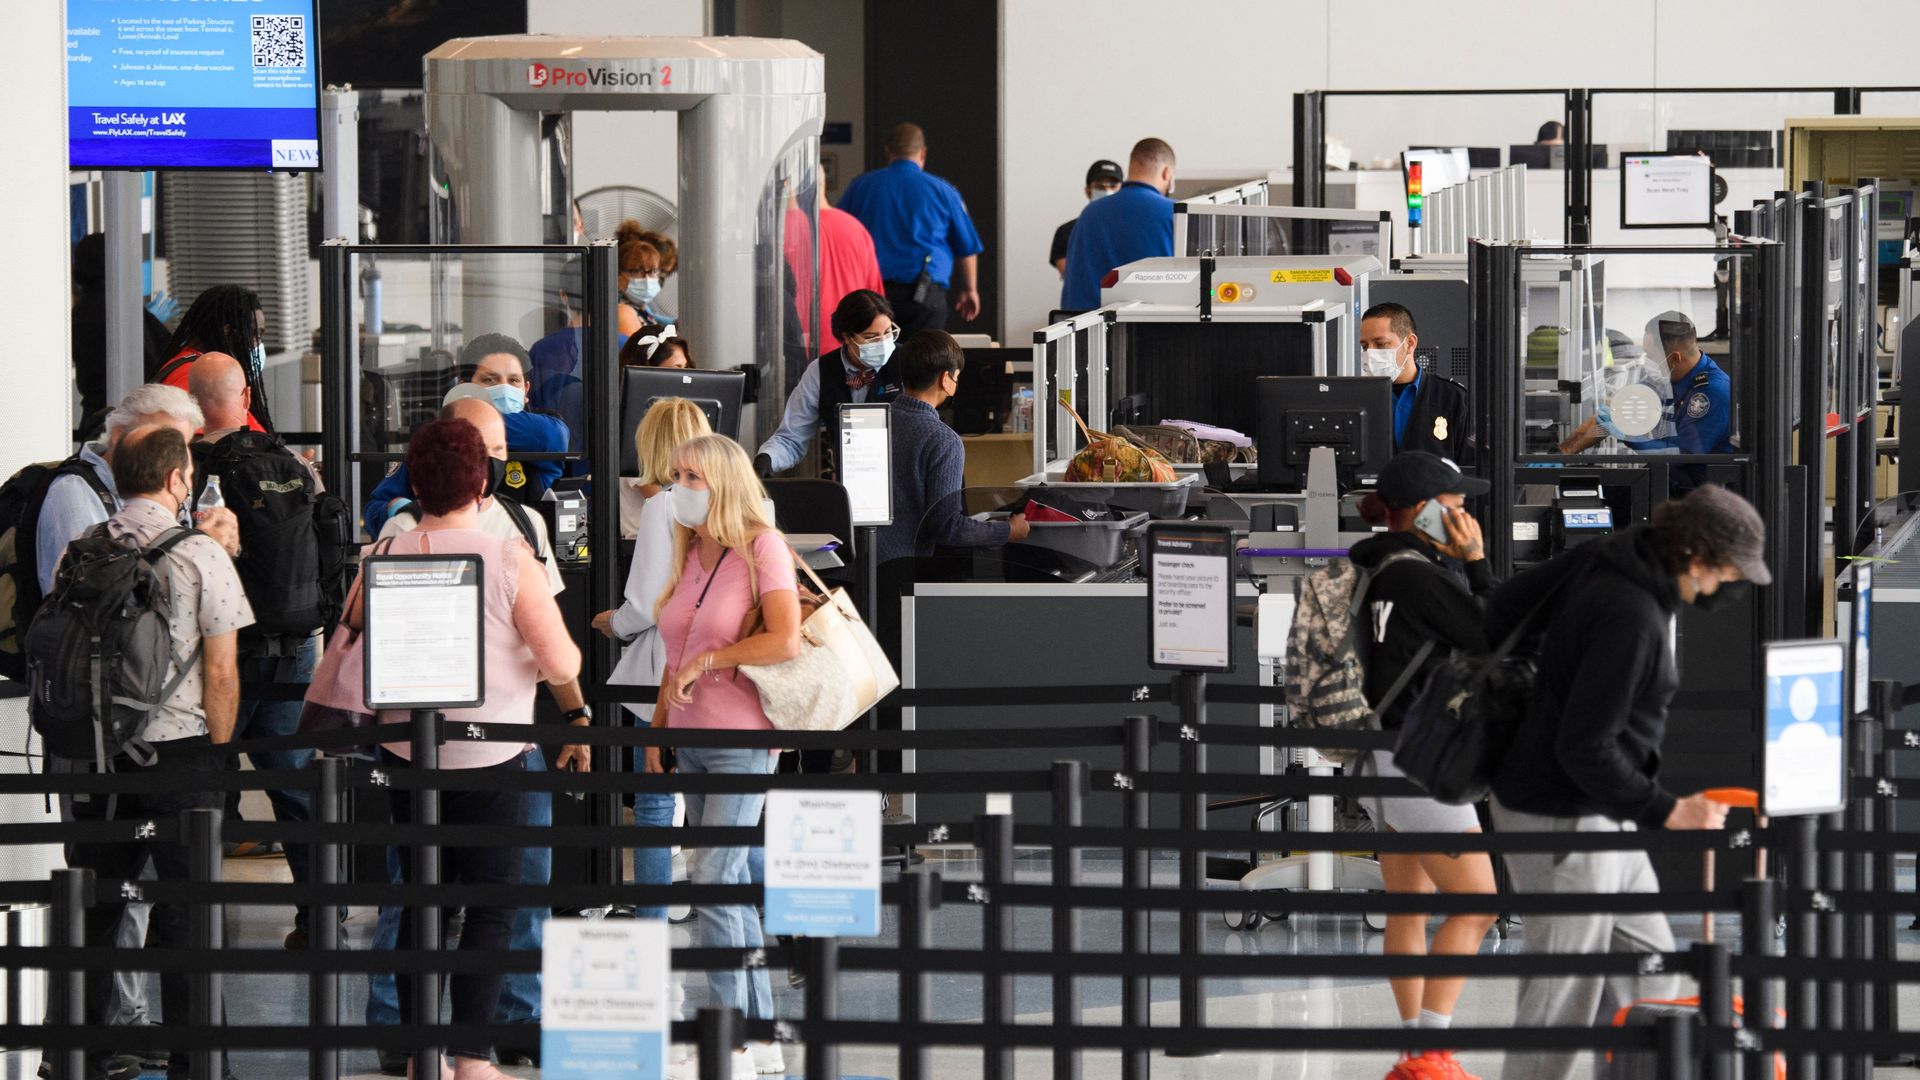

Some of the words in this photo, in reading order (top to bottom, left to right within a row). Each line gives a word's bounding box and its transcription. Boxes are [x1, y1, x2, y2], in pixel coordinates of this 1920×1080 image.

[67, 53, 92, 63] turday
[552, 68, 651, 86] ProVision
[660, 64, 672, 87] 2
[92, 113, 120, 124] Travel
[121, 113, 148, 127] Safely
[150, 116, 160, 125] at
[162, 113, 186, 125] LAX
[1134, 274, 1163, 282] Rapiscan
[822, 860, 870, 870] Distance
